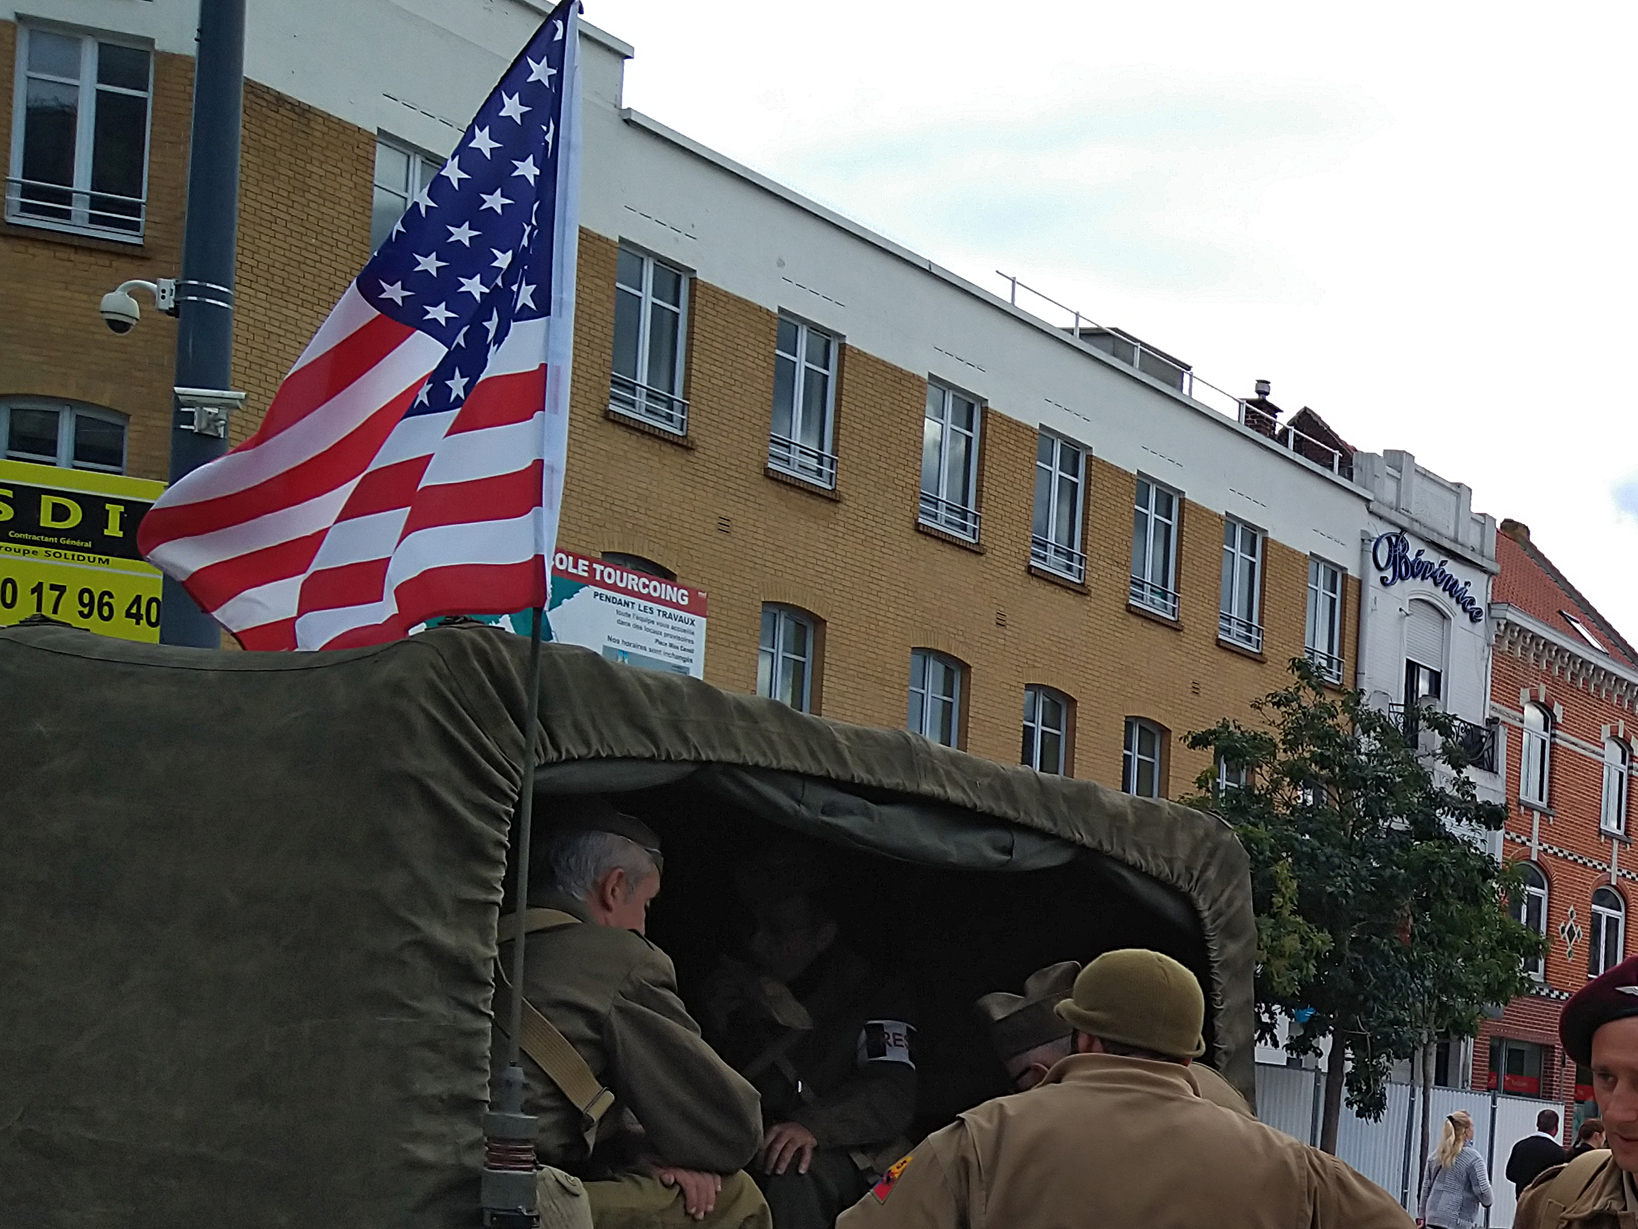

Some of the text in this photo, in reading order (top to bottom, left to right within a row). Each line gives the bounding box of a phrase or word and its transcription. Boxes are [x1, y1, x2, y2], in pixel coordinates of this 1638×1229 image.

[8, 530, 92, 548] Contractant Général
[44, 550, 110, 565] SOLIDUM
[551, 552, 690, 606] OLE TOURCOING
[1372, 529, 1483, 623] Bérénice
[30, 581, 67, 615] 17
[77, 587, 115, 622] 96
[124, 594, 162, 629] 40
[593, 590, 696, 627] PENDANT LES TRAVAUX
[607, 634, 620, 646] Nos
[621, 639, 647, 652] horaires
